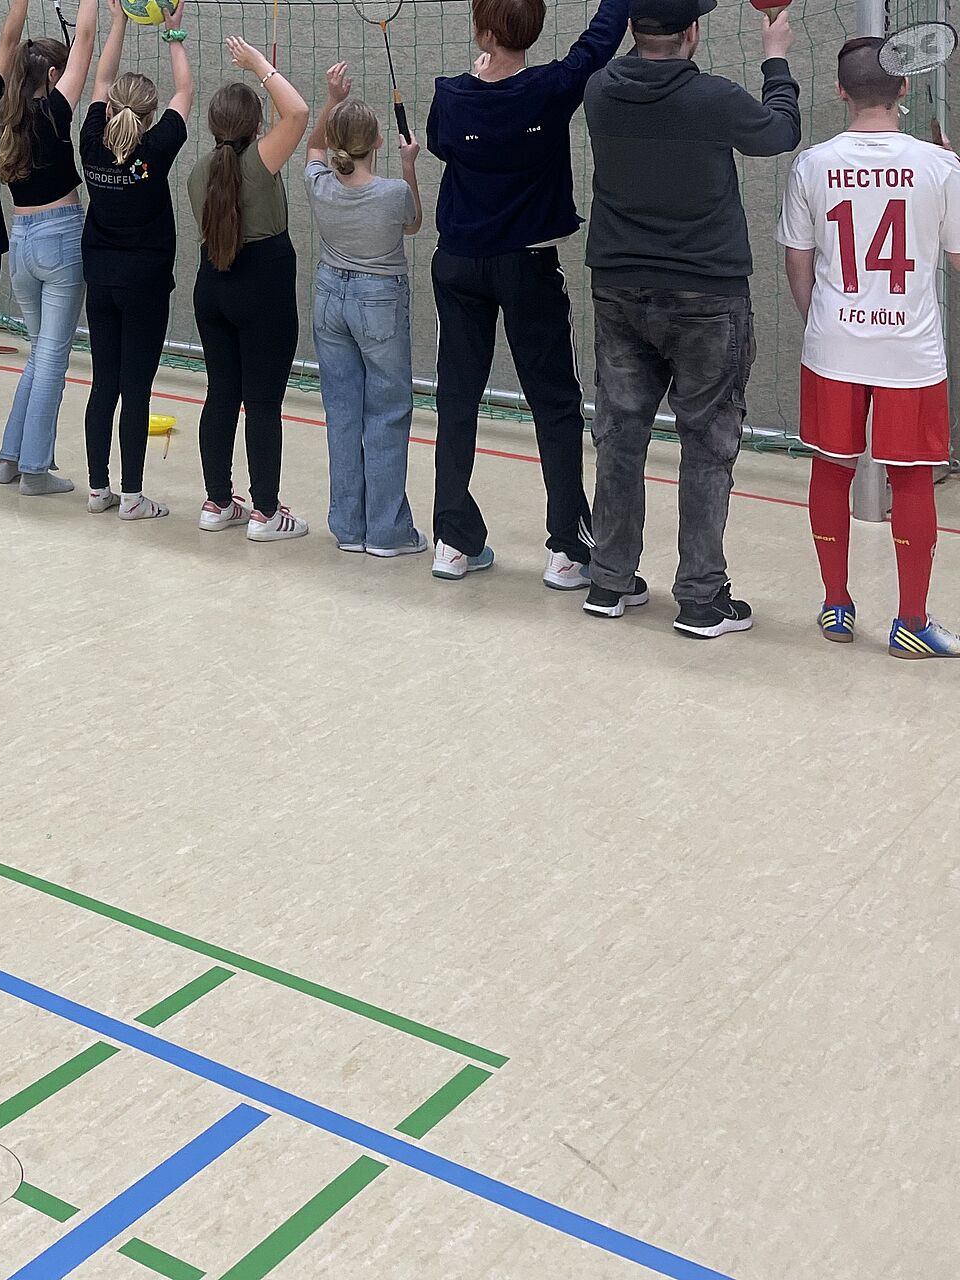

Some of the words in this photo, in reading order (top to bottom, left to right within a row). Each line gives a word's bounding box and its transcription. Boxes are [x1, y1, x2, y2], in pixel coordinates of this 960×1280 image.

[828, 169, 914, 188] HECTOR
[826, 199, 915, 294] 14
[849, 309, 866, 324] FC
[871, 308, 905, 326] KÖLN
